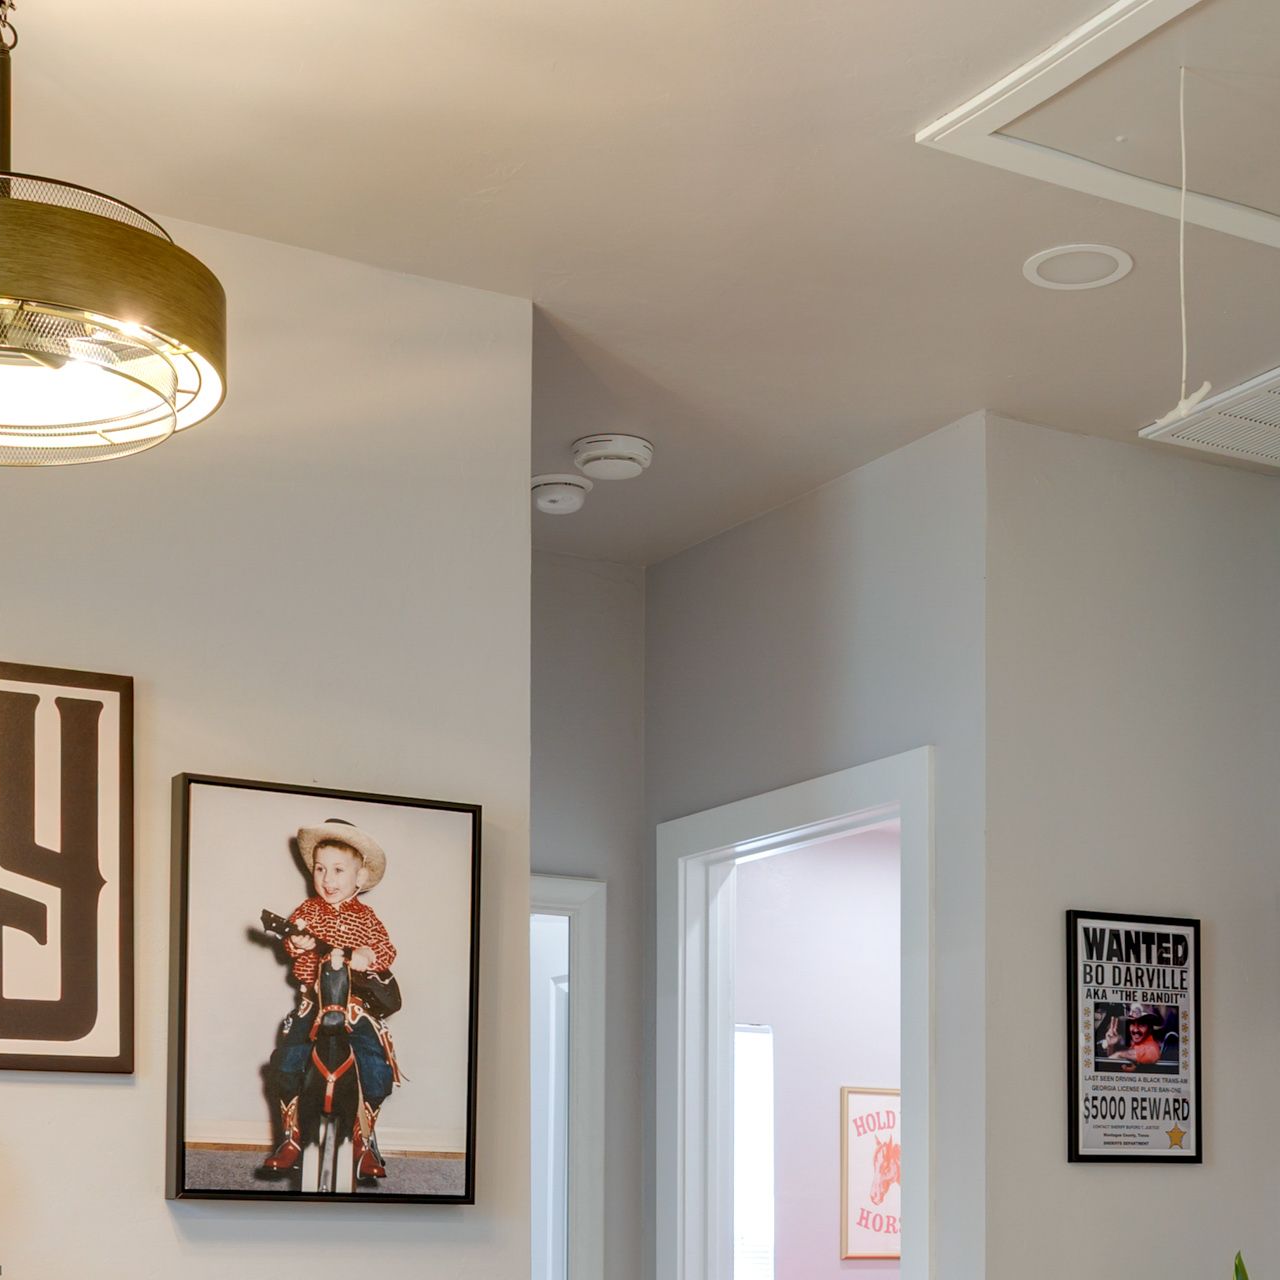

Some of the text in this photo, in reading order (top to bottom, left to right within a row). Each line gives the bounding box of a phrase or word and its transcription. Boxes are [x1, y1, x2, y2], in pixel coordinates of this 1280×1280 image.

[1083, 927, 1189, 967] WANTED
[1083, 963, 1188, 990] BO DARVILLE
[1085, 988, 1186, 1004] AKA "THE BANDIT"
[1083, 1093, 1190, 1124] $5000 REWARD
[852, 1110, 896, 1137] HOLD
